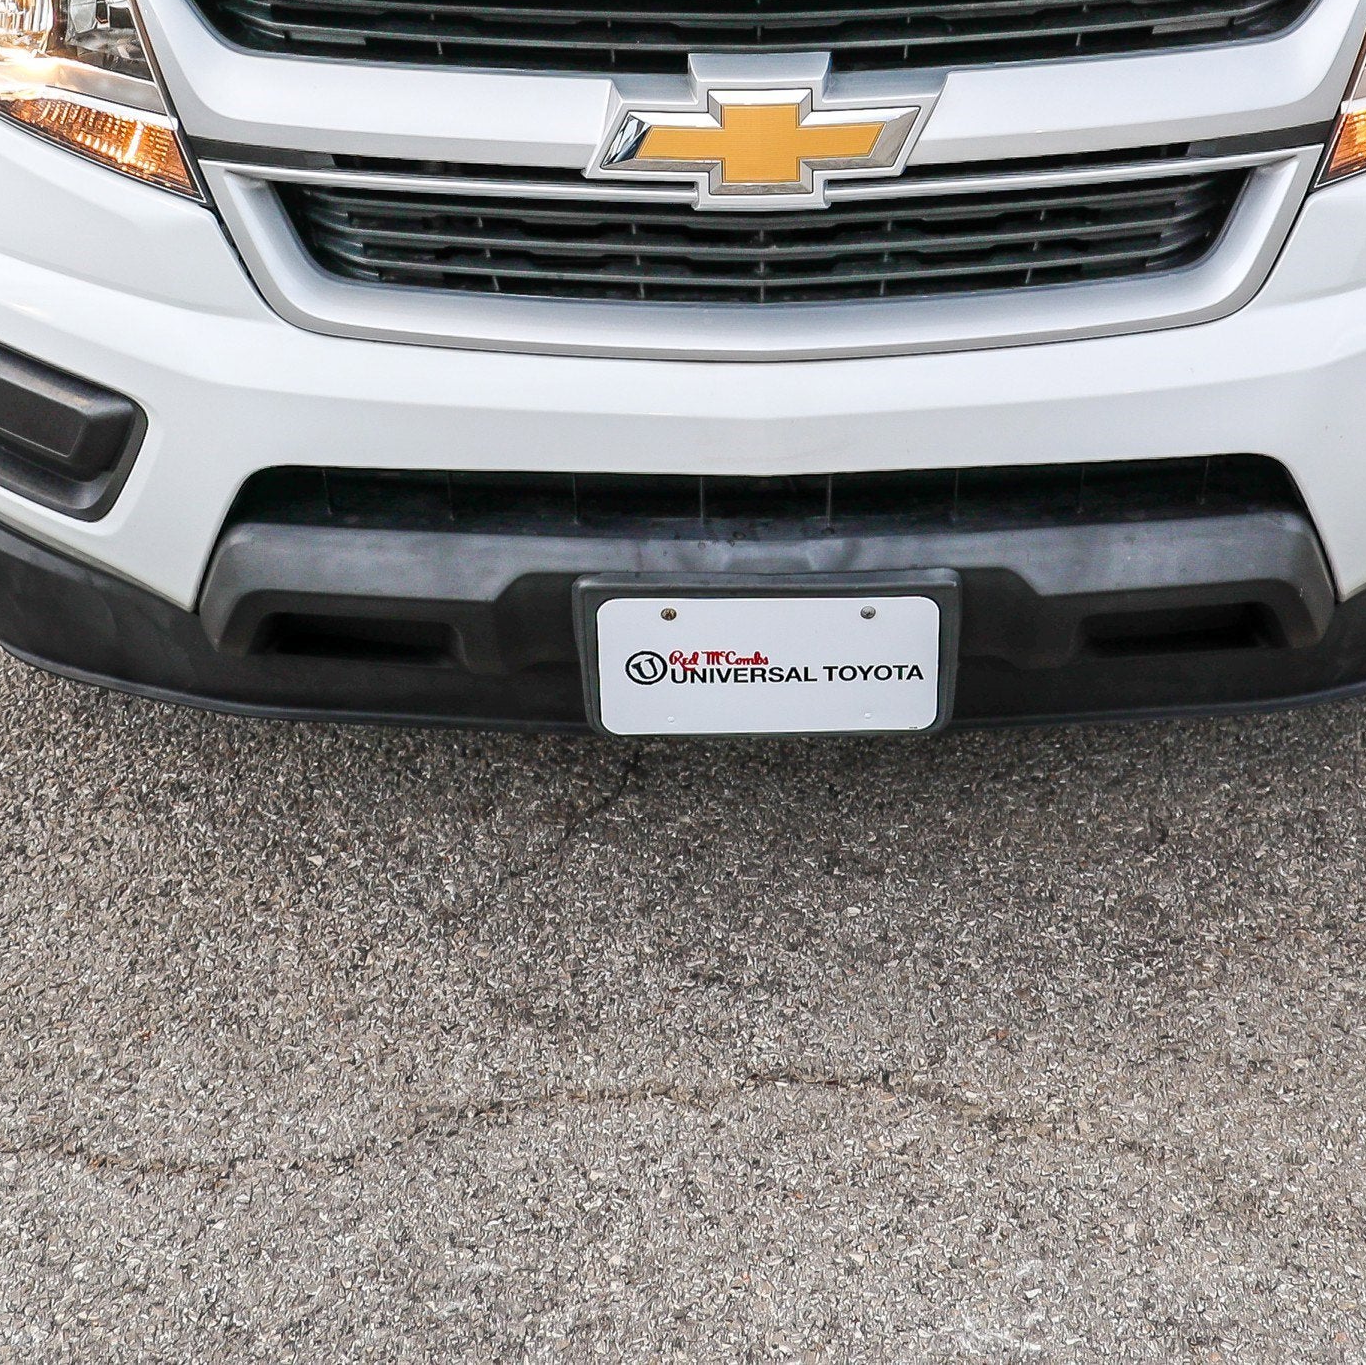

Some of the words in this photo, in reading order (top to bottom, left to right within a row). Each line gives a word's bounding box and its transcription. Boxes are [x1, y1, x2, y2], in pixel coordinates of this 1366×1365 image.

[669, 650, 699, 671] Red
[701, 650, 768, 666] McCombs
[671, 667, 818, 684] UNIVERSAL
[823, 665, 924, 682] TOYOTA
